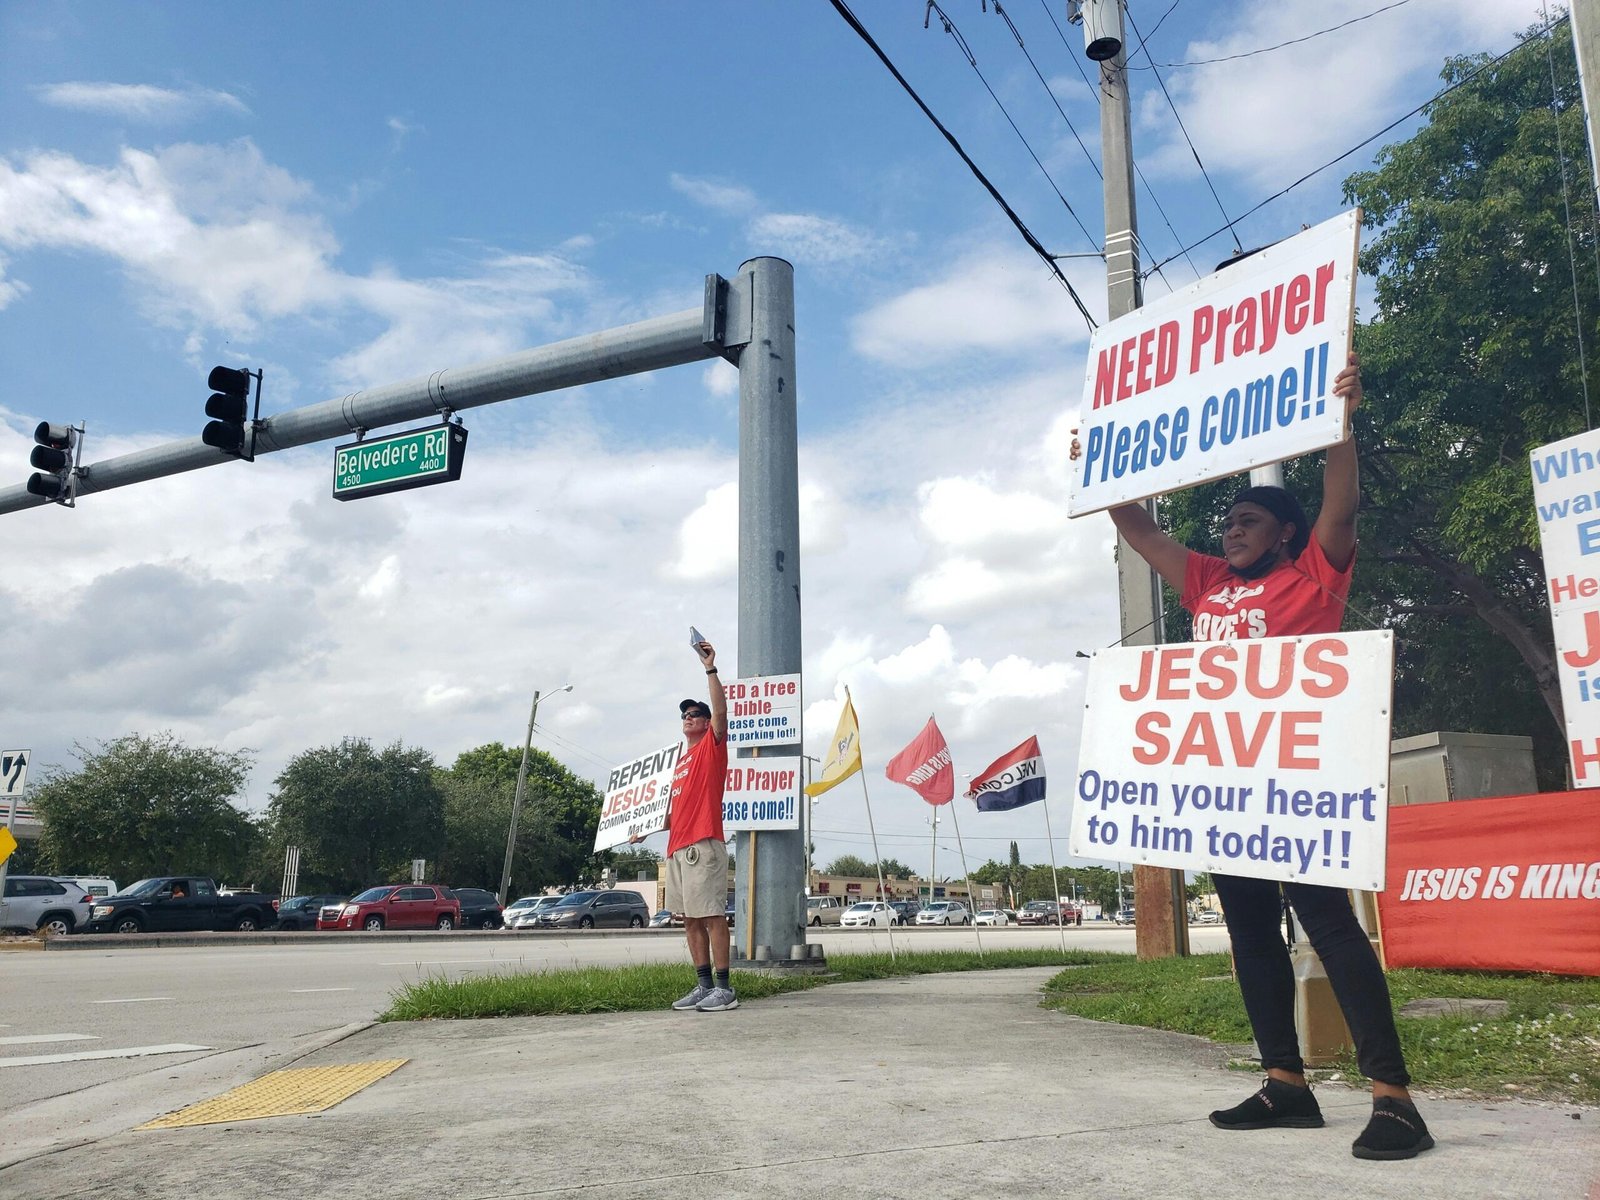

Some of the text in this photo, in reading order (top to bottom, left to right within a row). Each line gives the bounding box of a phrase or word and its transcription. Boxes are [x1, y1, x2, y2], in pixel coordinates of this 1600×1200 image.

[1093, 260, 1335, 410] NEED Prayer
[1083, 341, 1330, 488] Please come!!
[338, 432, 446, 476] Belvedere Rd
[342, 458, 439, 487] 4500 4400
[1533, 447, 1600, 484] Wh
[1551, 574, 1600, 604] He
[1119, 638, 1349, 702] JESUS
[734, 699, 772, 717] bible
[751, 685, 760, 698] a
[764, 681, 796, 697] free
[729, 716, 788, 730] ease come
[740, 730, 774, 742] parking
[777, 728, 796, 739] lot!!
[1132, 711, 1323, 770] SAVE
[607, 746, 679, 793] REPENT
[726, 768, 743, 792] ED
[746, 768, 795, 793] Prayer
[602, 779, 670, 818] JESUS IS
[721, 796, 794, 820] ease come!!
[1079, 769, 1377, 822] Open your heart
[598, 798, 668, 832] COMING SOON!!!
[628, 814, 665, 836] Mat 4:17
[1087, 814, 1352, 875] to him today!!
[1400, 862, 1600, 900] JESUS IS KING
